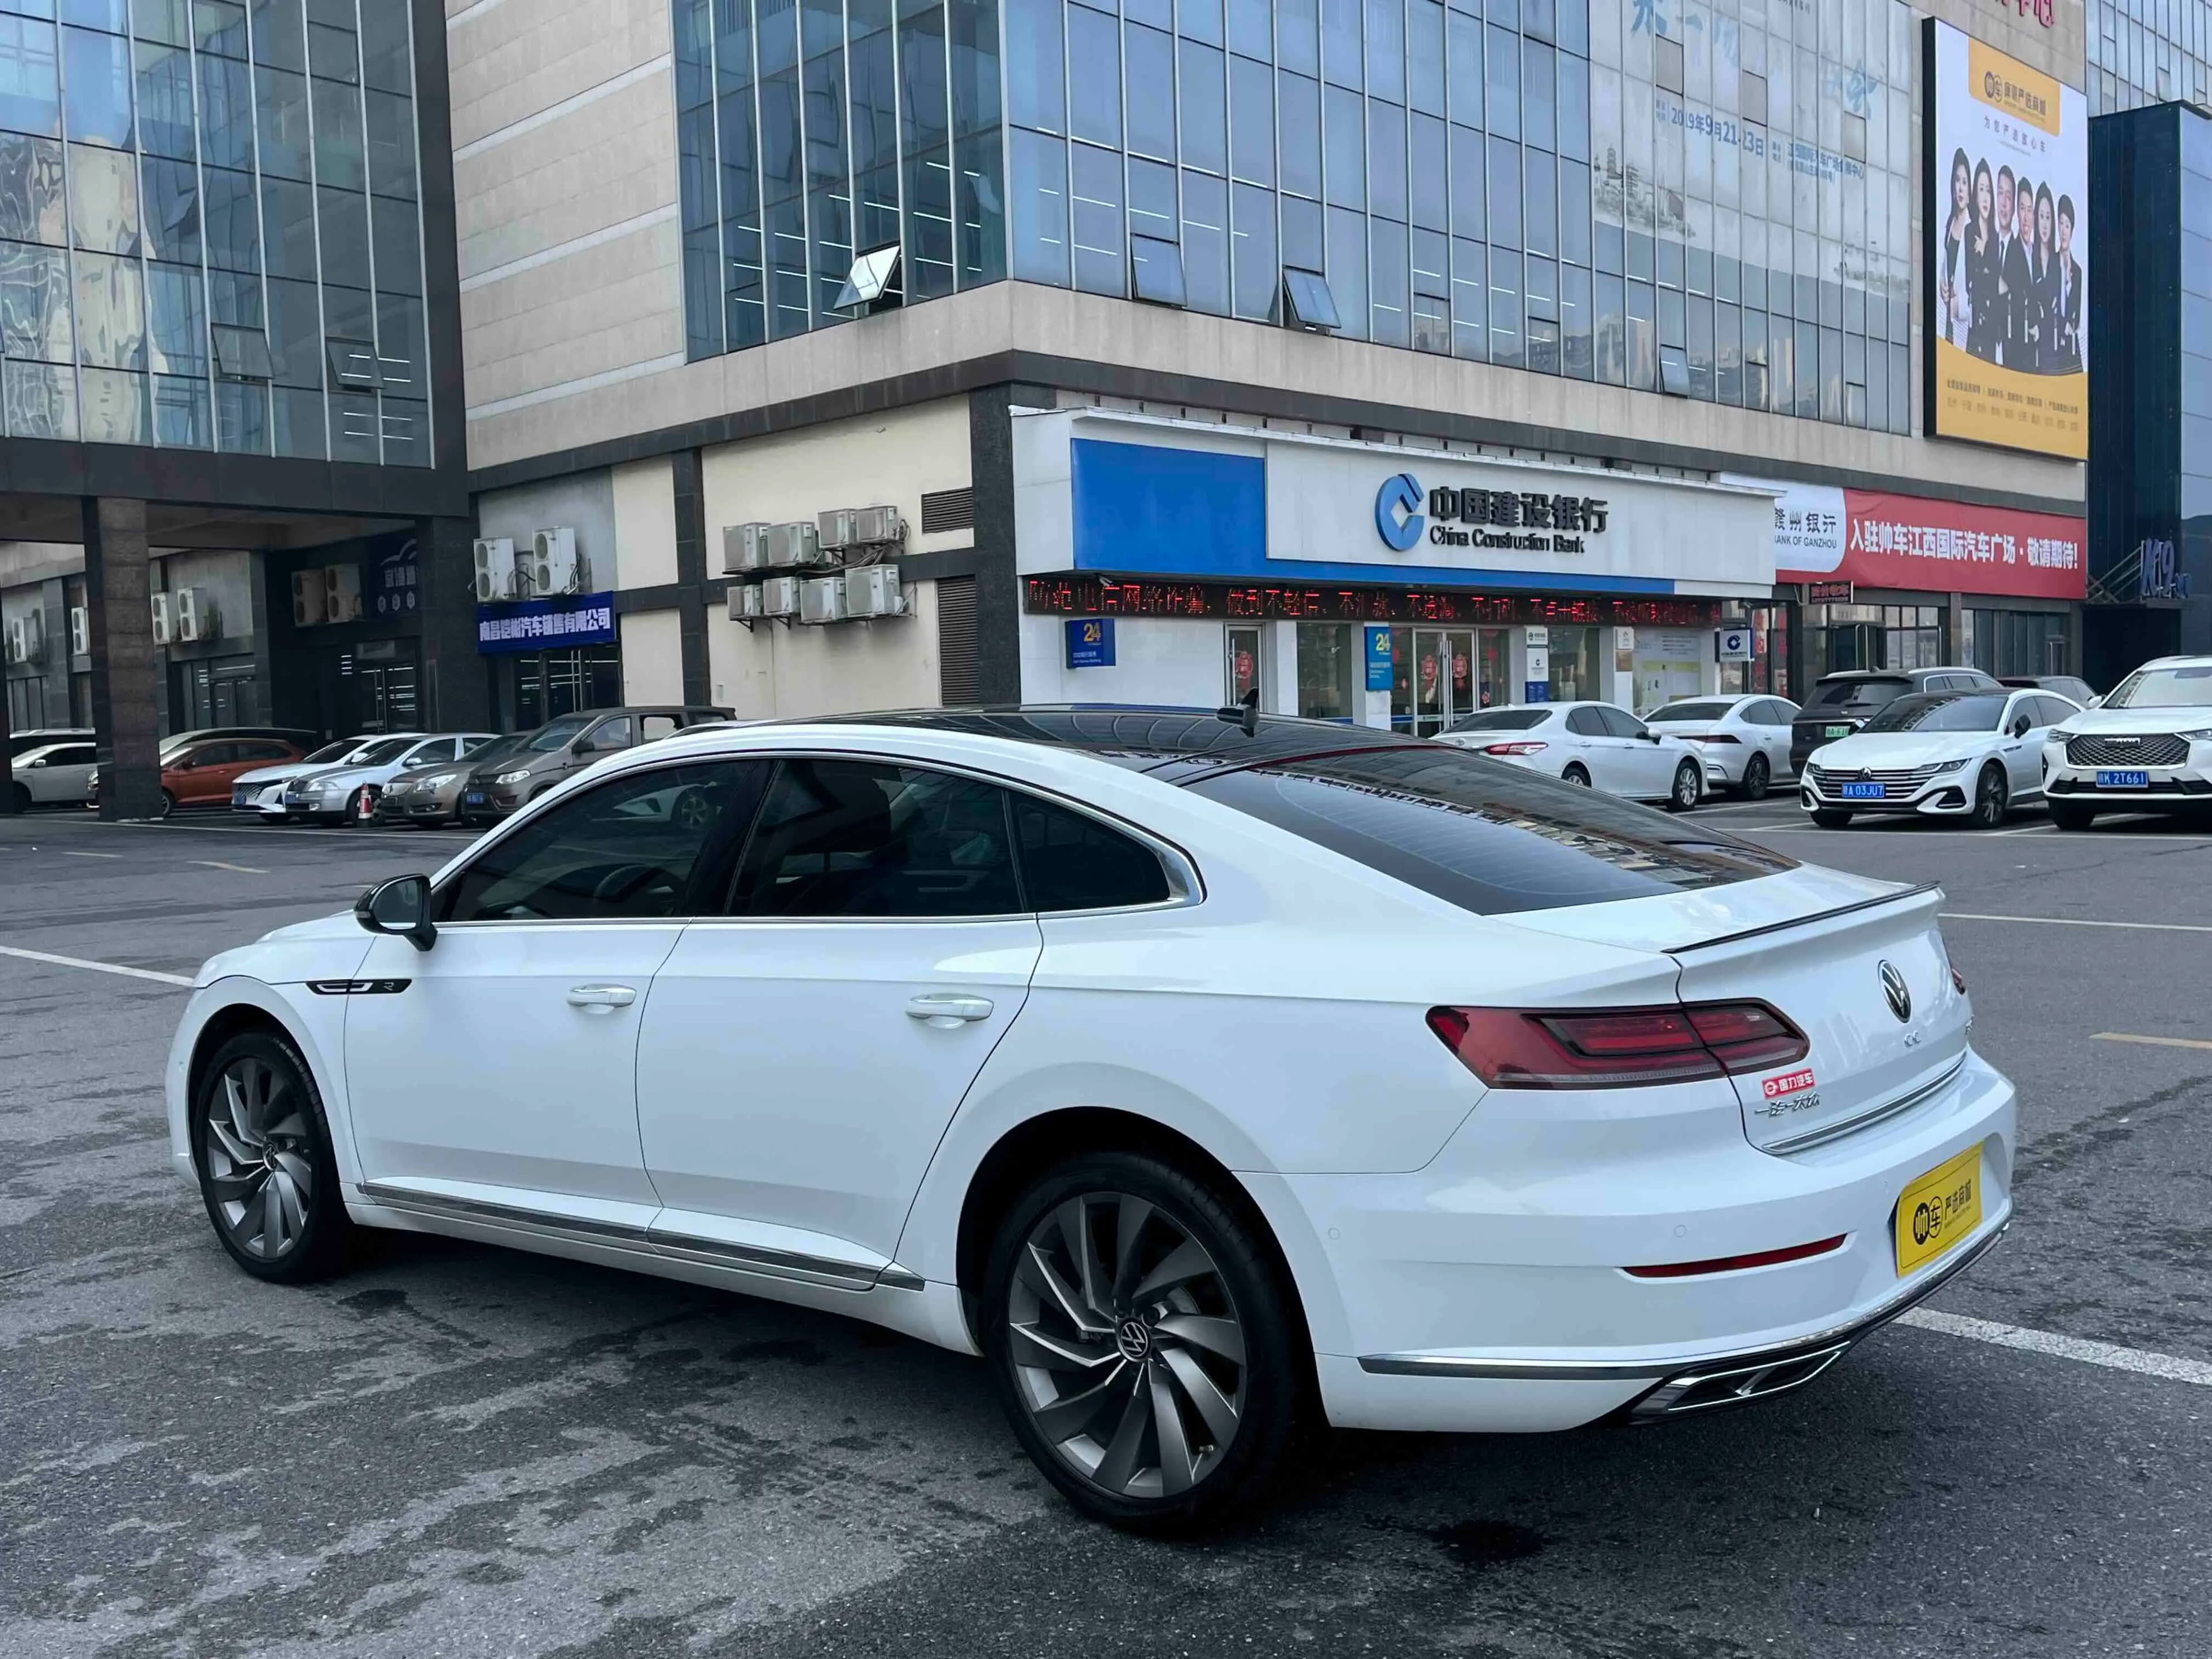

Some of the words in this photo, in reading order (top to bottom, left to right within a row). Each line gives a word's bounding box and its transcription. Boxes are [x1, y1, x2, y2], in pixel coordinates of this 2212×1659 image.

[1429, 486, 1608, 533] 中国建设银行
[1430, 525, 1469, 547] China
[1472, 529, 1550, 551] Construction
[1553, 535, 1585, 553] Bank
[1774, 535, 1791, 546] ANK
[1793, 536, 1803, 546] OF
[1804, 537, 1836, 548] GANZHOU
[1084, 622, 1101, 642] 24
[1375, 632, 1391, 652] 24
[1904, 1029, 1922, 1047] CC
